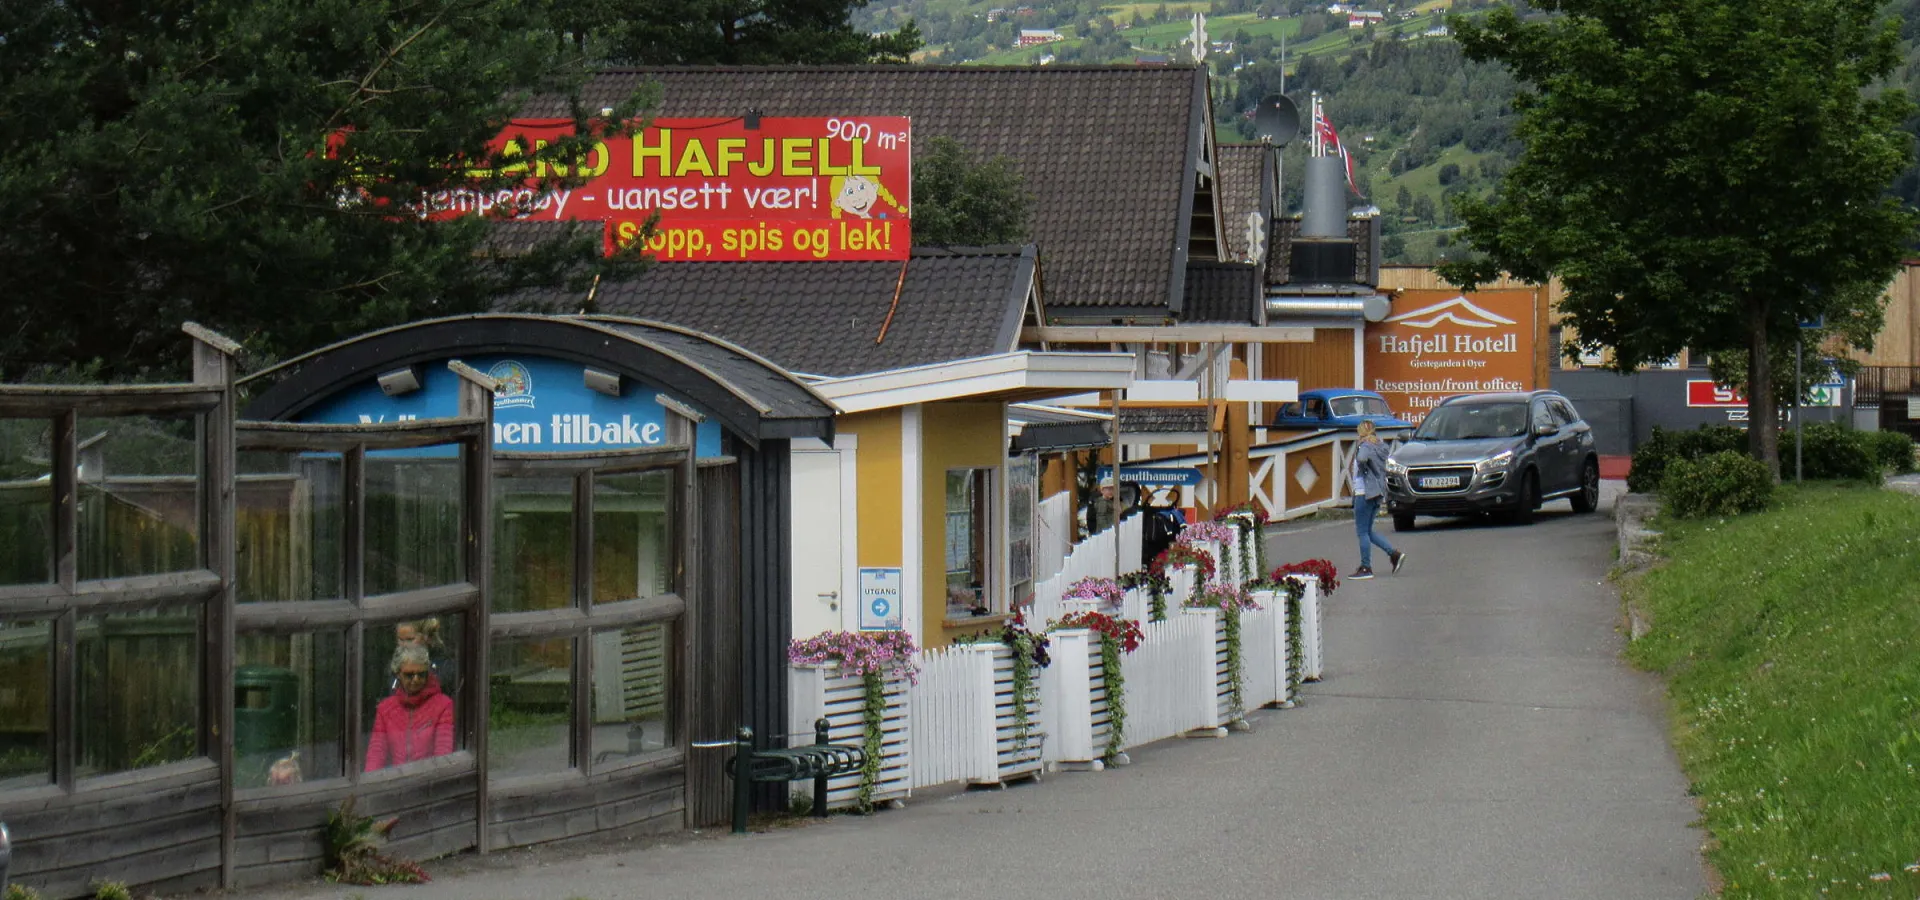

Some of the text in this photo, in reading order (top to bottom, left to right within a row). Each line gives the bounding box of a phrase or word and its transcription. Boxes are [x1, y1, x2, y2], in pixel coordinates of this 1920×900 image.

[826, 118, 871, 144] 900
[631, 128, 882, 177] HAFJELL
[607, 182, 732, 210] uansett
[743, 178, 818, 210] vær!
[721, 221, 784, 258] spis
[792, 227, 830, 257] og
[839, 221, 892, 250] lek!
[1379, 333, 1517, 358] Hafjell Hotell
[1374, 377, 1523, 393] Resepsjon/front office:
[550, 414, 661, 444] tilbake
